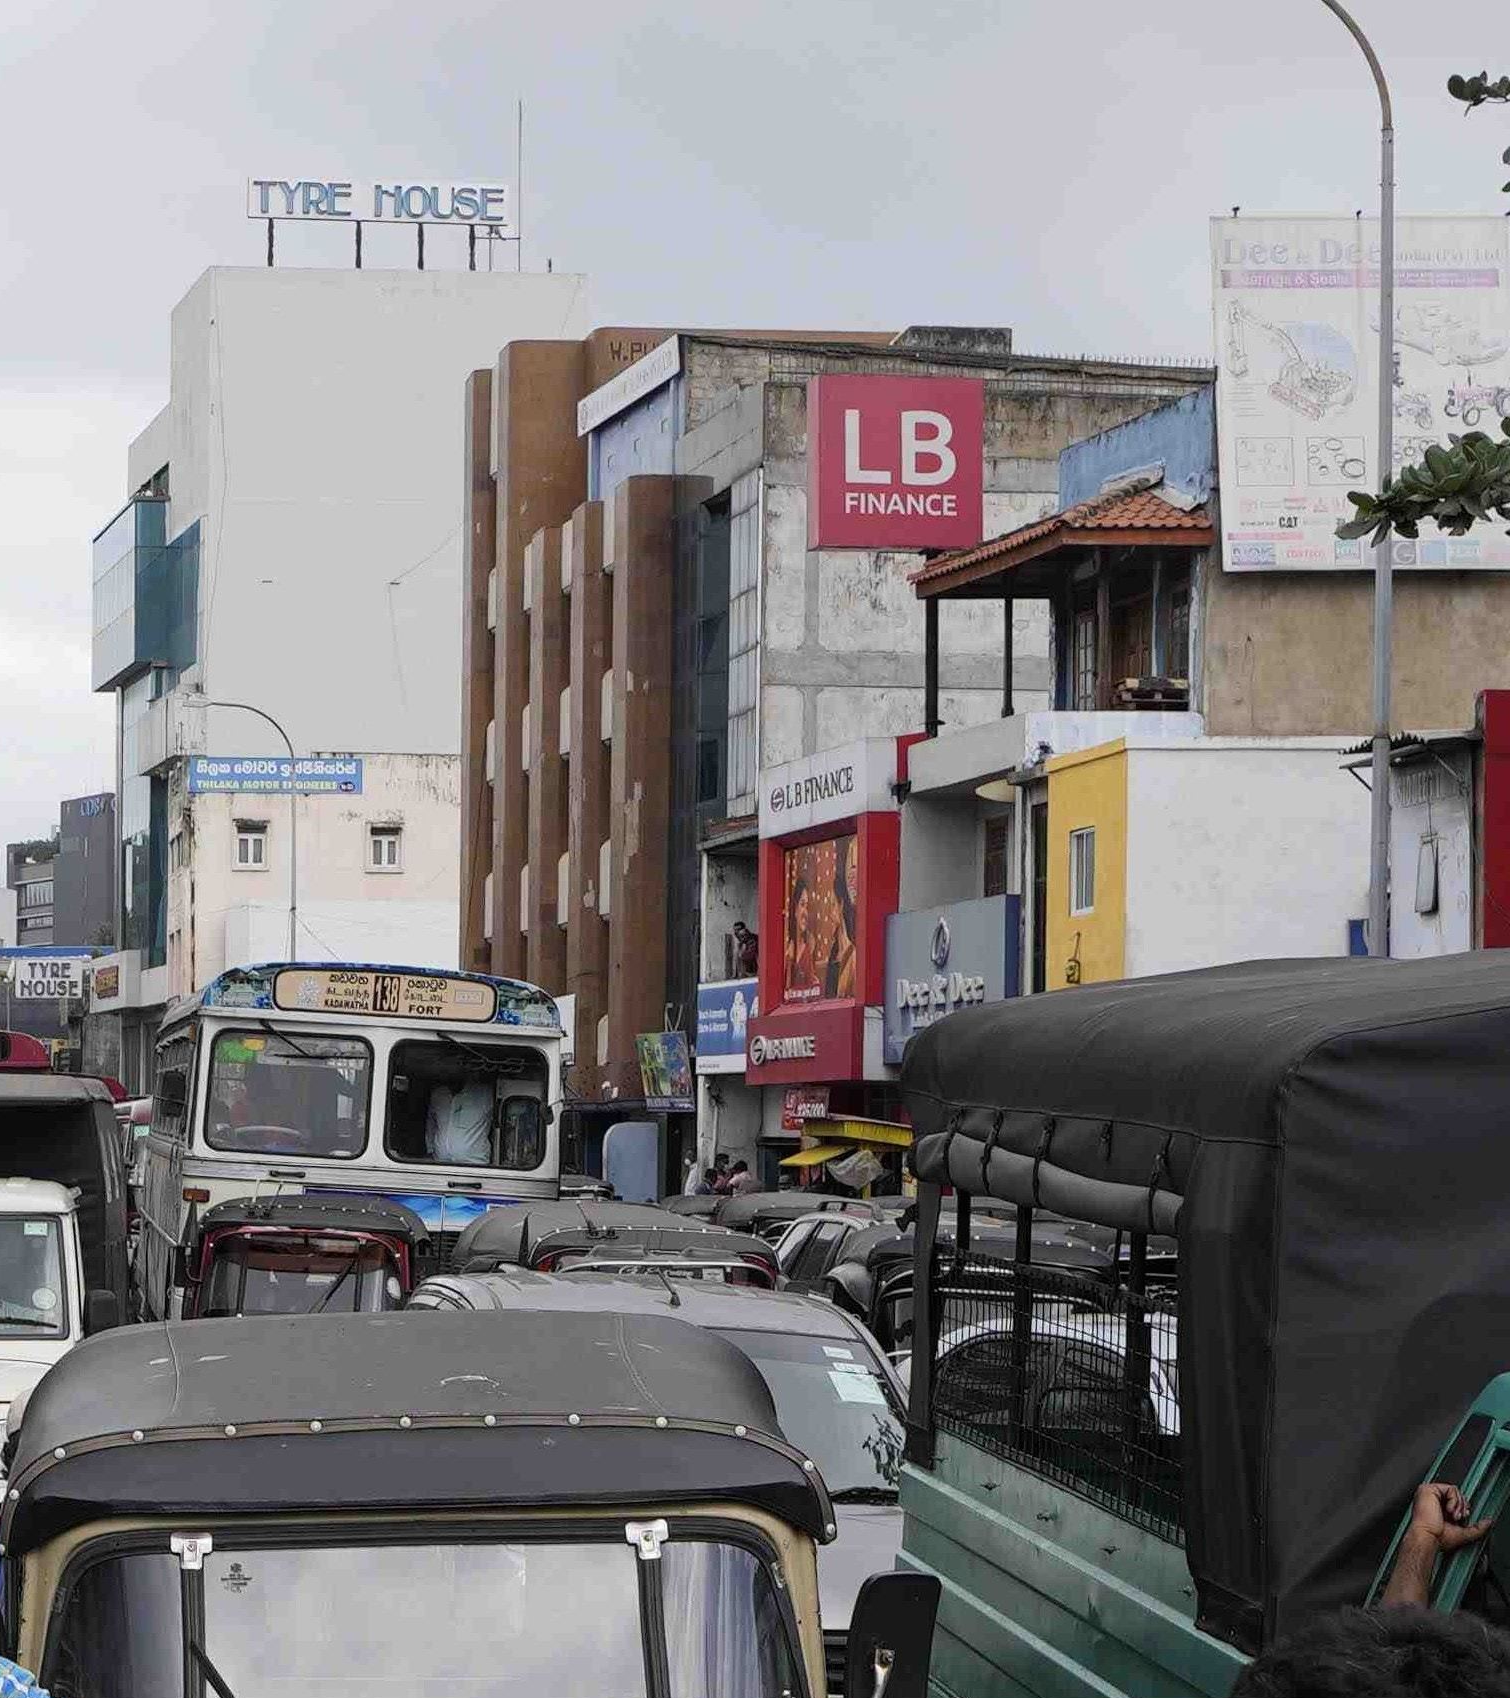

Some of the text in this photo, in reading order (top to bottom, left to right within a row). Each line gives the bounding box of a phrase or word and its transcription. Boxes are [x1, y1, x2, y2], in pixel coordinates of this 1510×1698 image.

[253, 180, 505, 221] TYRE HOUSE
[844, 408, 957, 487] LB
[844, 491, 958, 517] FINANCE
[243, 780, 280, 790] MOTOR
[804, 765, 855, 805] FINANCE
[27, 962, 72, 979] TYRE
[19, 980, 80, 998] HOUSE
[375, 976, 399, 1012] 138
[896, 979, 931, 1007] Dee
[948, 971, 985, 1003] Dee
[323, 999, 370, 1011] KADAWATHA
[408, 1004, 443, 1016] FORT
